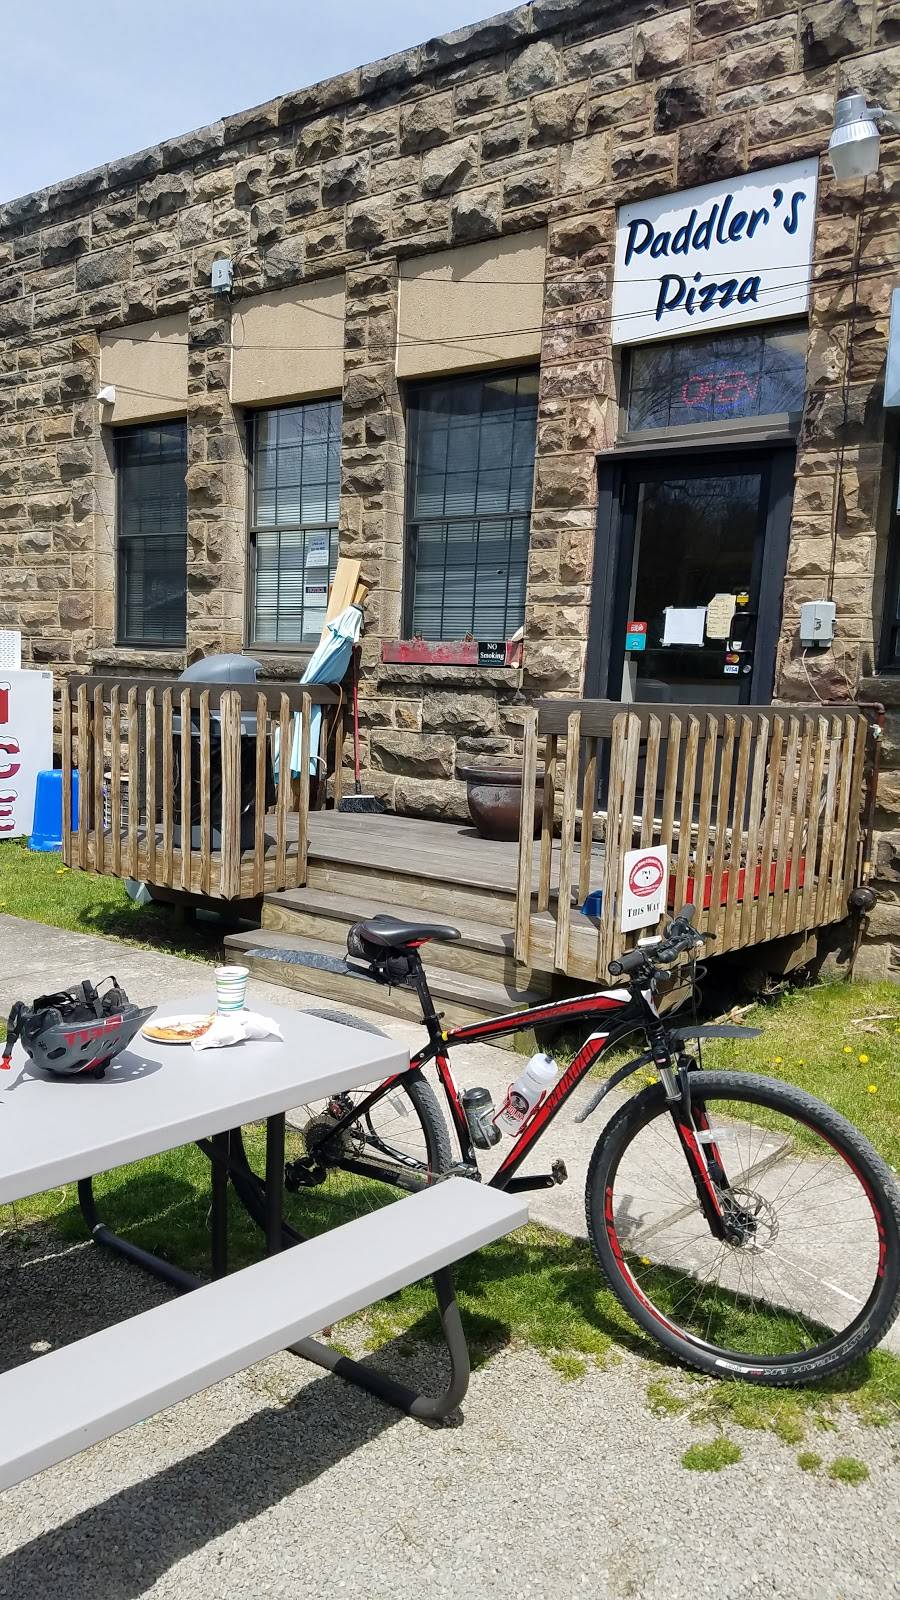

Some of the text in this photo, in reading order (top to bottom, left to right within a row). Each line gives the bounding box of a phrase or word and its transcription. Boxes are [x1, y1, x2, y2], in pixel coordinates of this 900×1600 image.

[624, 188, 807, 267] Paddler's
[655, 272, 761, 322] Pizza
[480, 651, 504, 660] Smoking
